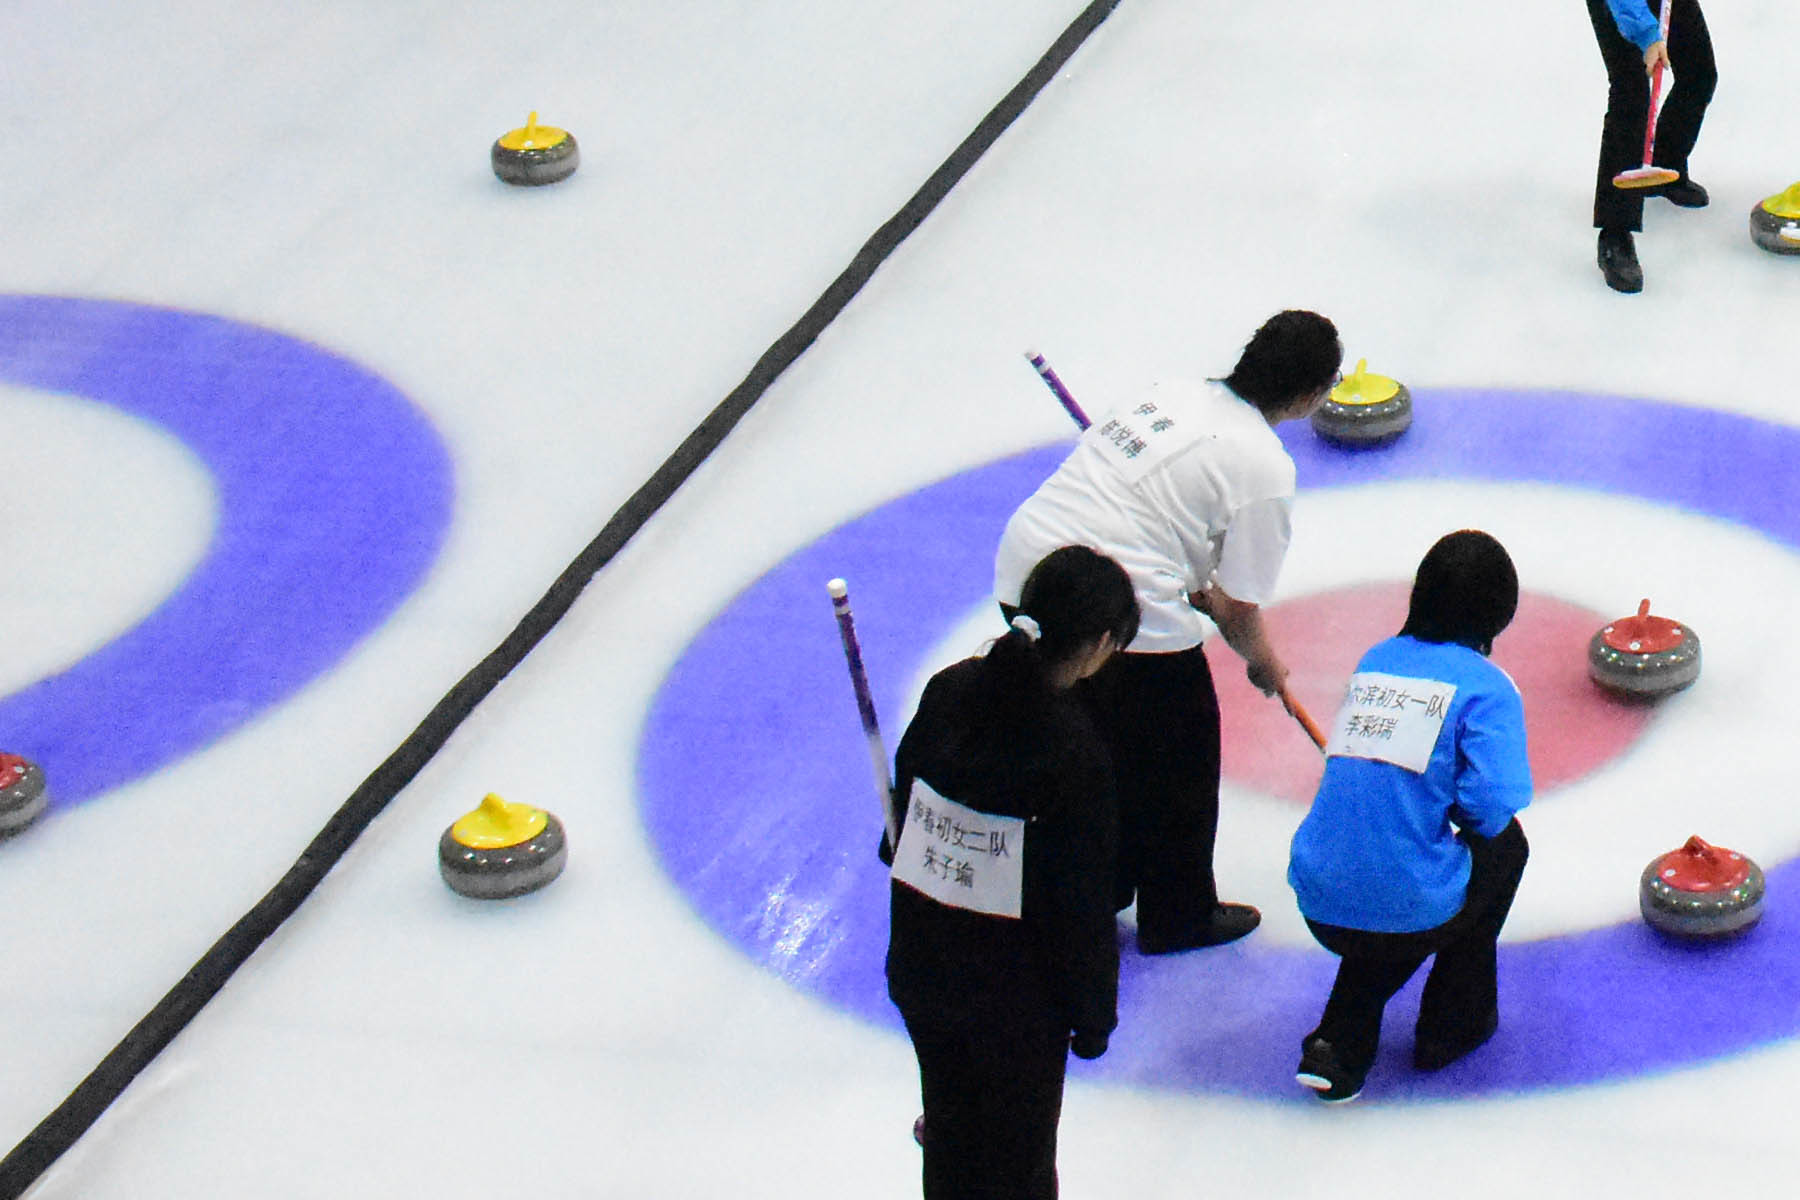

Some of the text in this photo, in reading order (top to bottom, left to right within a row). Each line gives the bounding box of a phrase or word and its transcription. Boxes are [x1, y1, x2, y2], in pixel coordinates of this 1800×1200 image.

[1346, 684, 1447, 720] 尔滨初女一队
[913, 797, 1010, 859] 伊春初女二队
